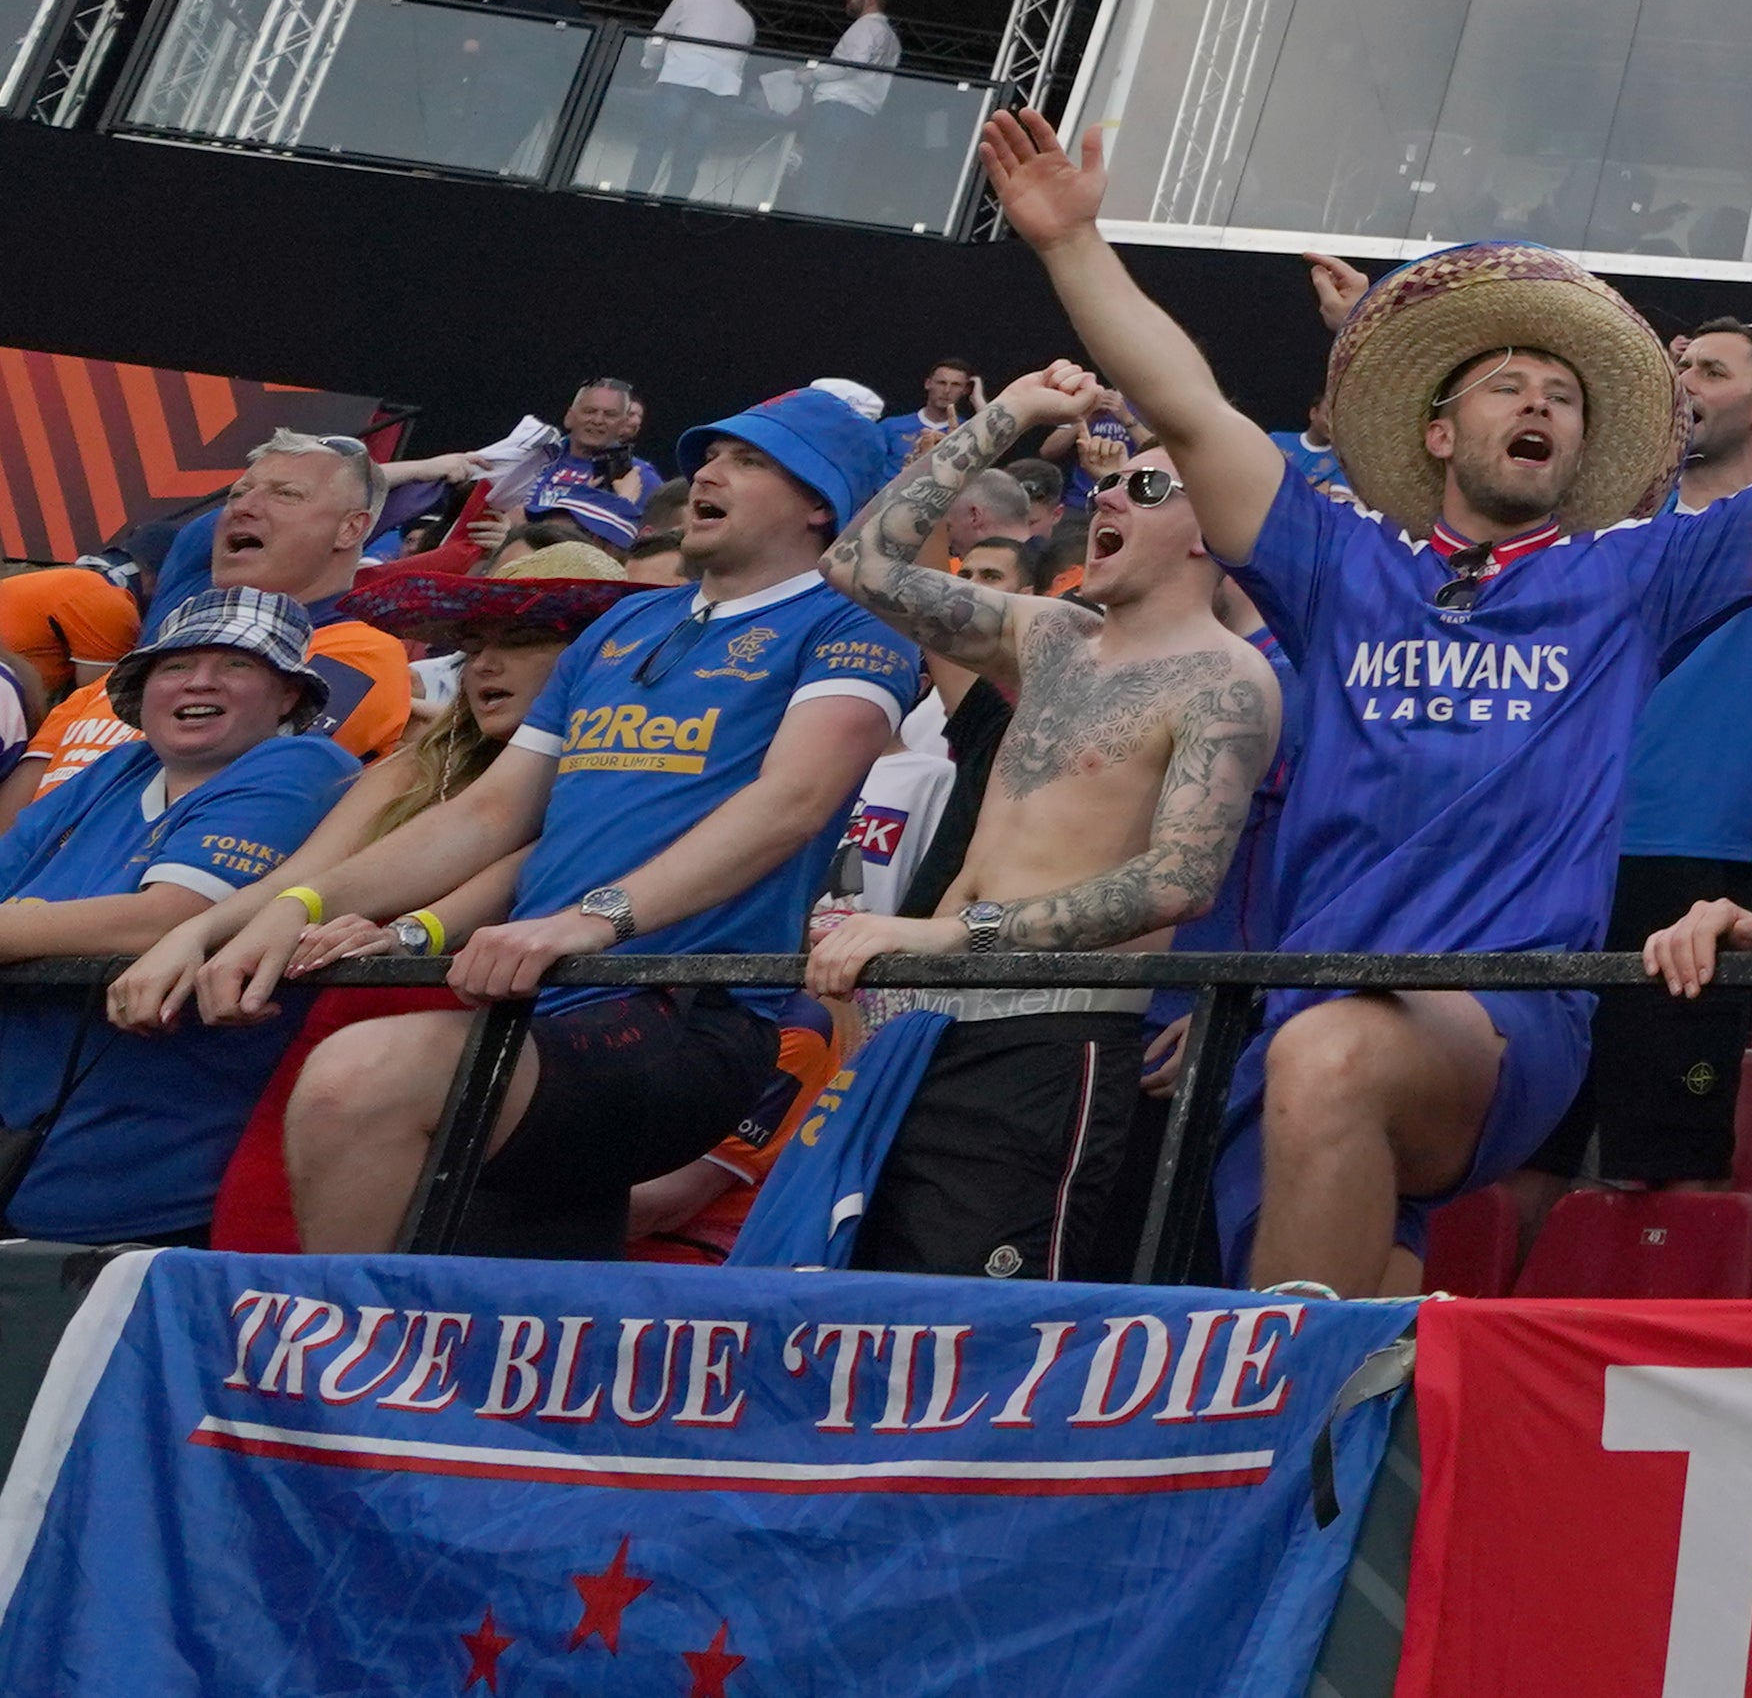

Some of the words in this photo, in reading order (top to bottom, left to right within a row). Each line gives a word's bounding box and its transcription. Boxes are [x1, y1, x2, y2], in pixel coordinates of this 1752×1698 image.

[827, 656, 893, 677] TIRES
[1362, 697, 1532, 722] LAGER
[621, 757, 666, 770] LIMITS
[229, 1288, 474, 1412] TRUE
[481, 1314, 750, 1422] BLUE
[990, 1319, 1078, 1426] I
[1070, 1305, 1306, 1424] DIE
